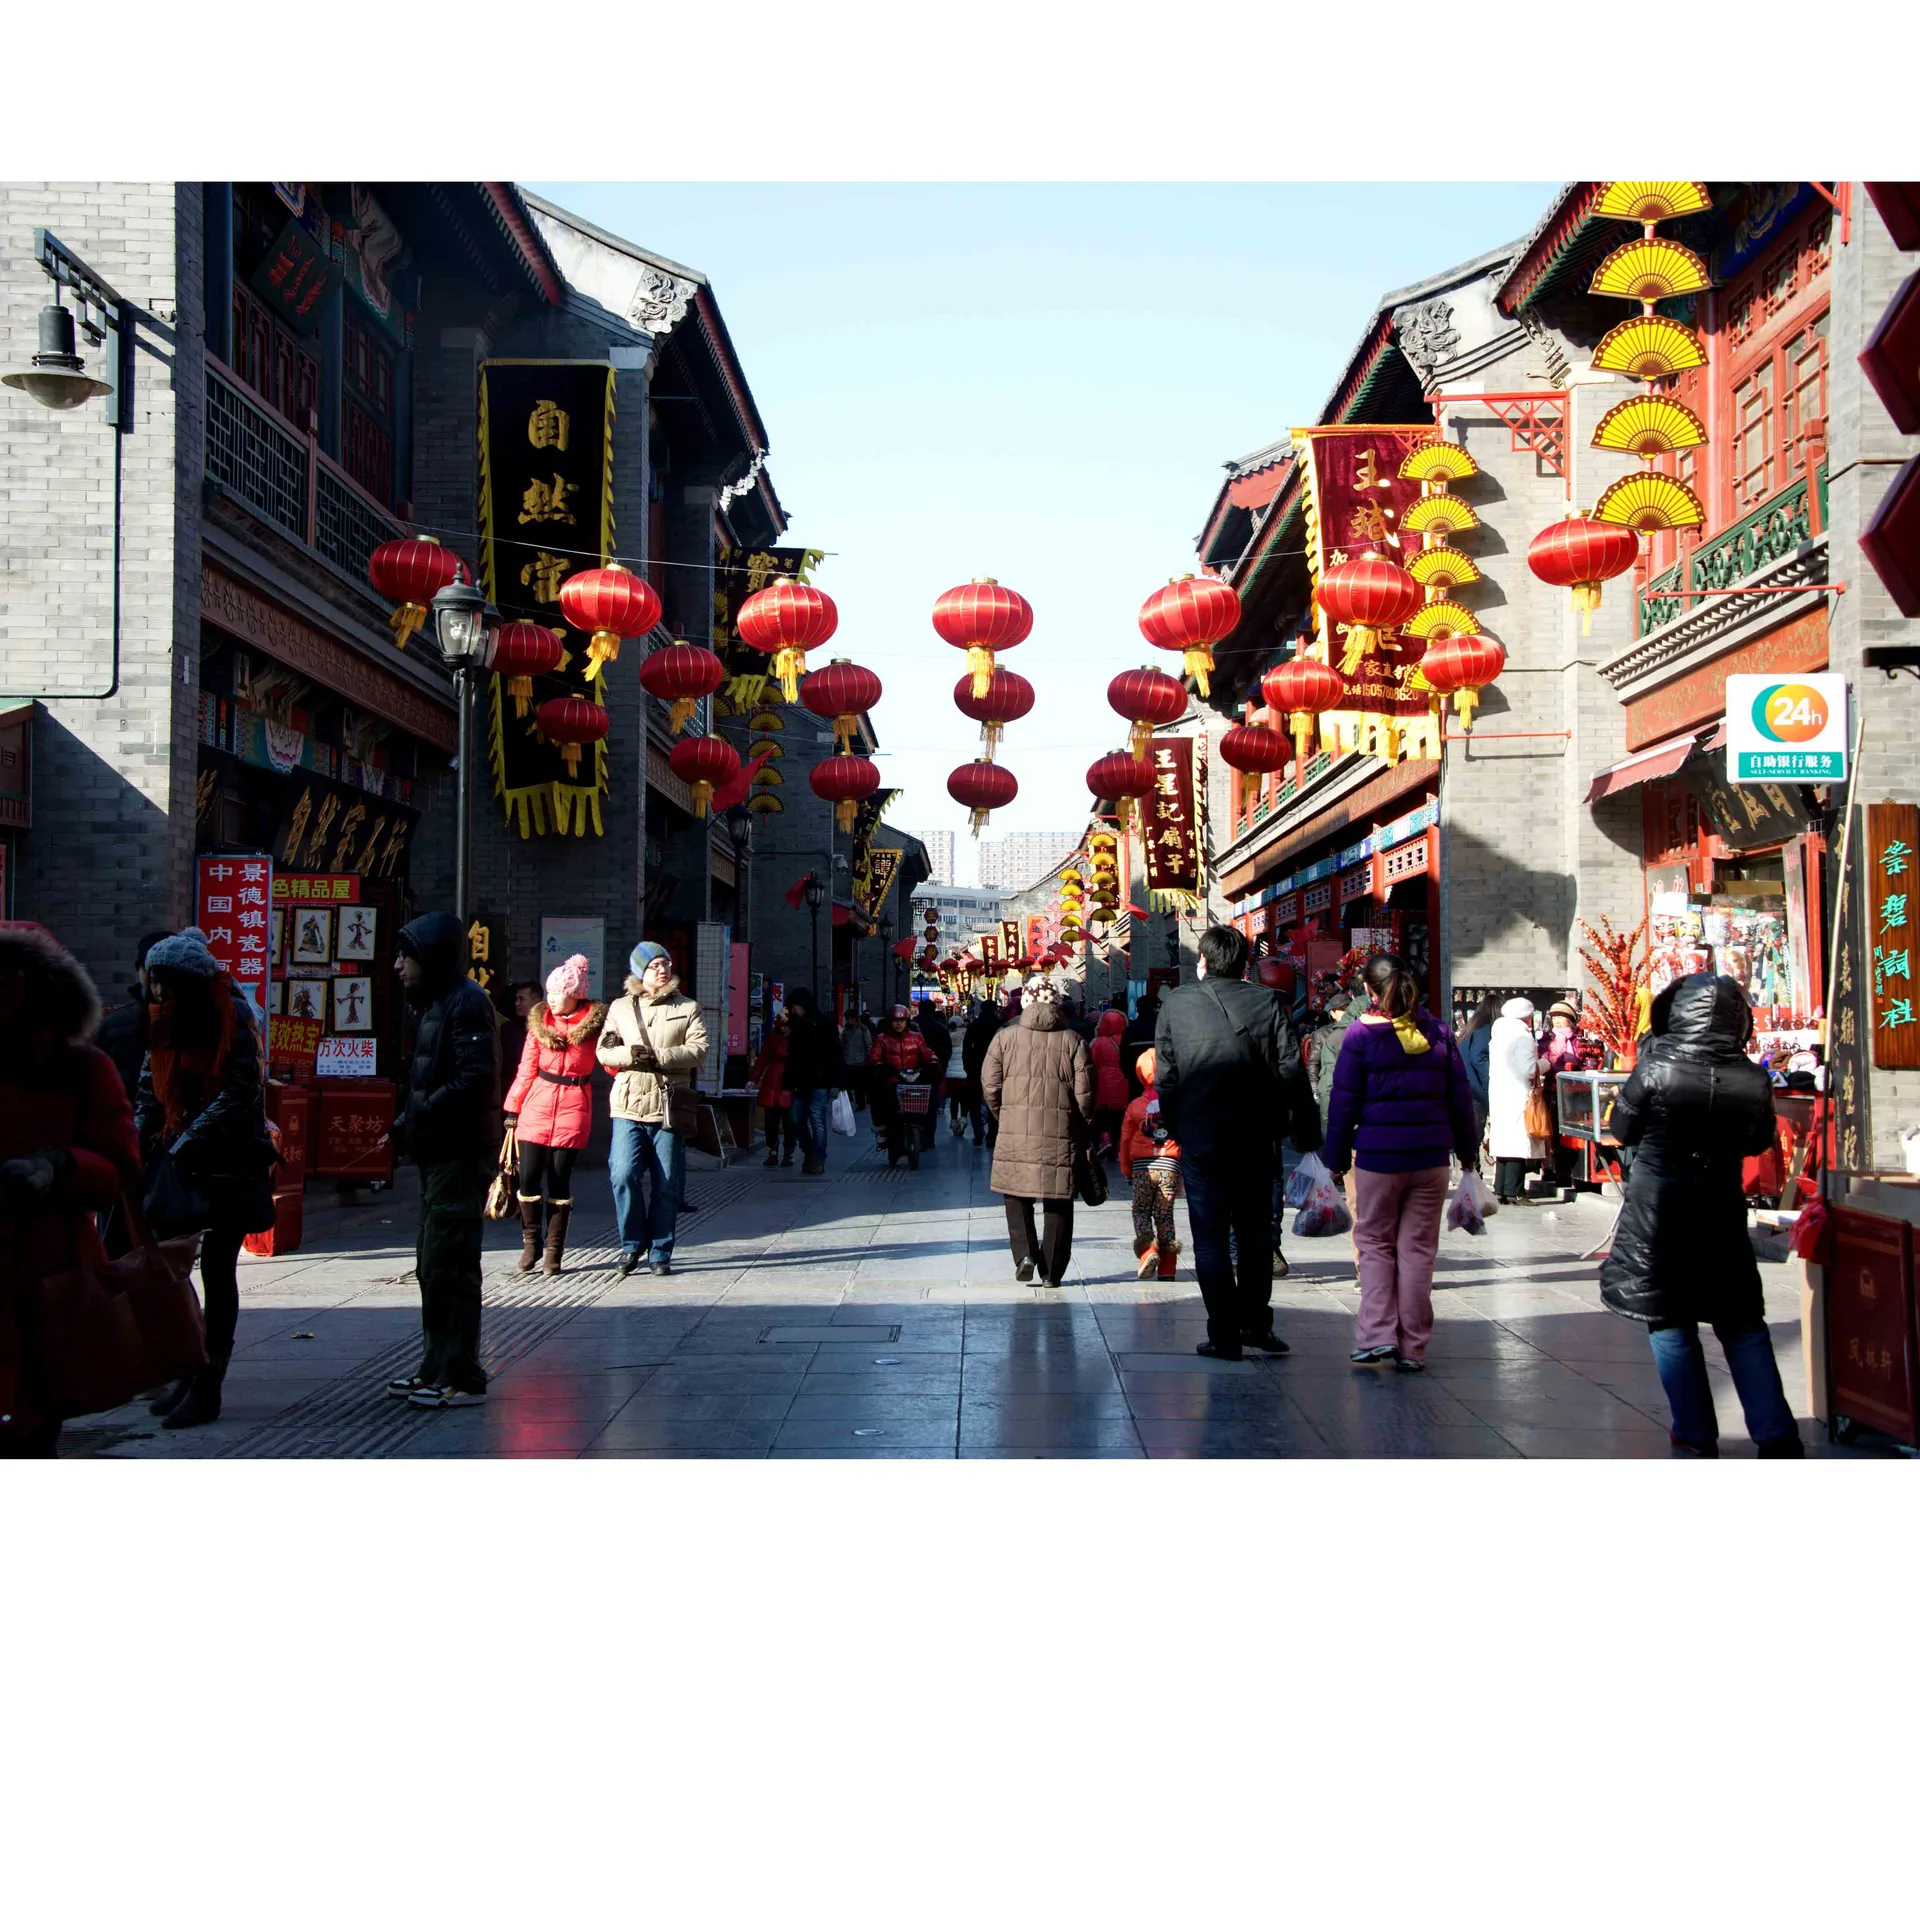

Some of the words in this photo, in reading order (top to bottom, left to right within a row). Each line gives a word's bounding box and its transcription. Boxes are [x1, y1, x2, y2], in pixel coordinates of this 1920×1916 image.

[1773, 697, 1822, 726] 24h
[1750, 754, 1833, 769] 自助银行服务
[237, 863, 267, 975] 景德镇瓷器
[319, 1039, 374, 1058] 万次火柴
[327, 1113, 385, 1134] 天聚坊
